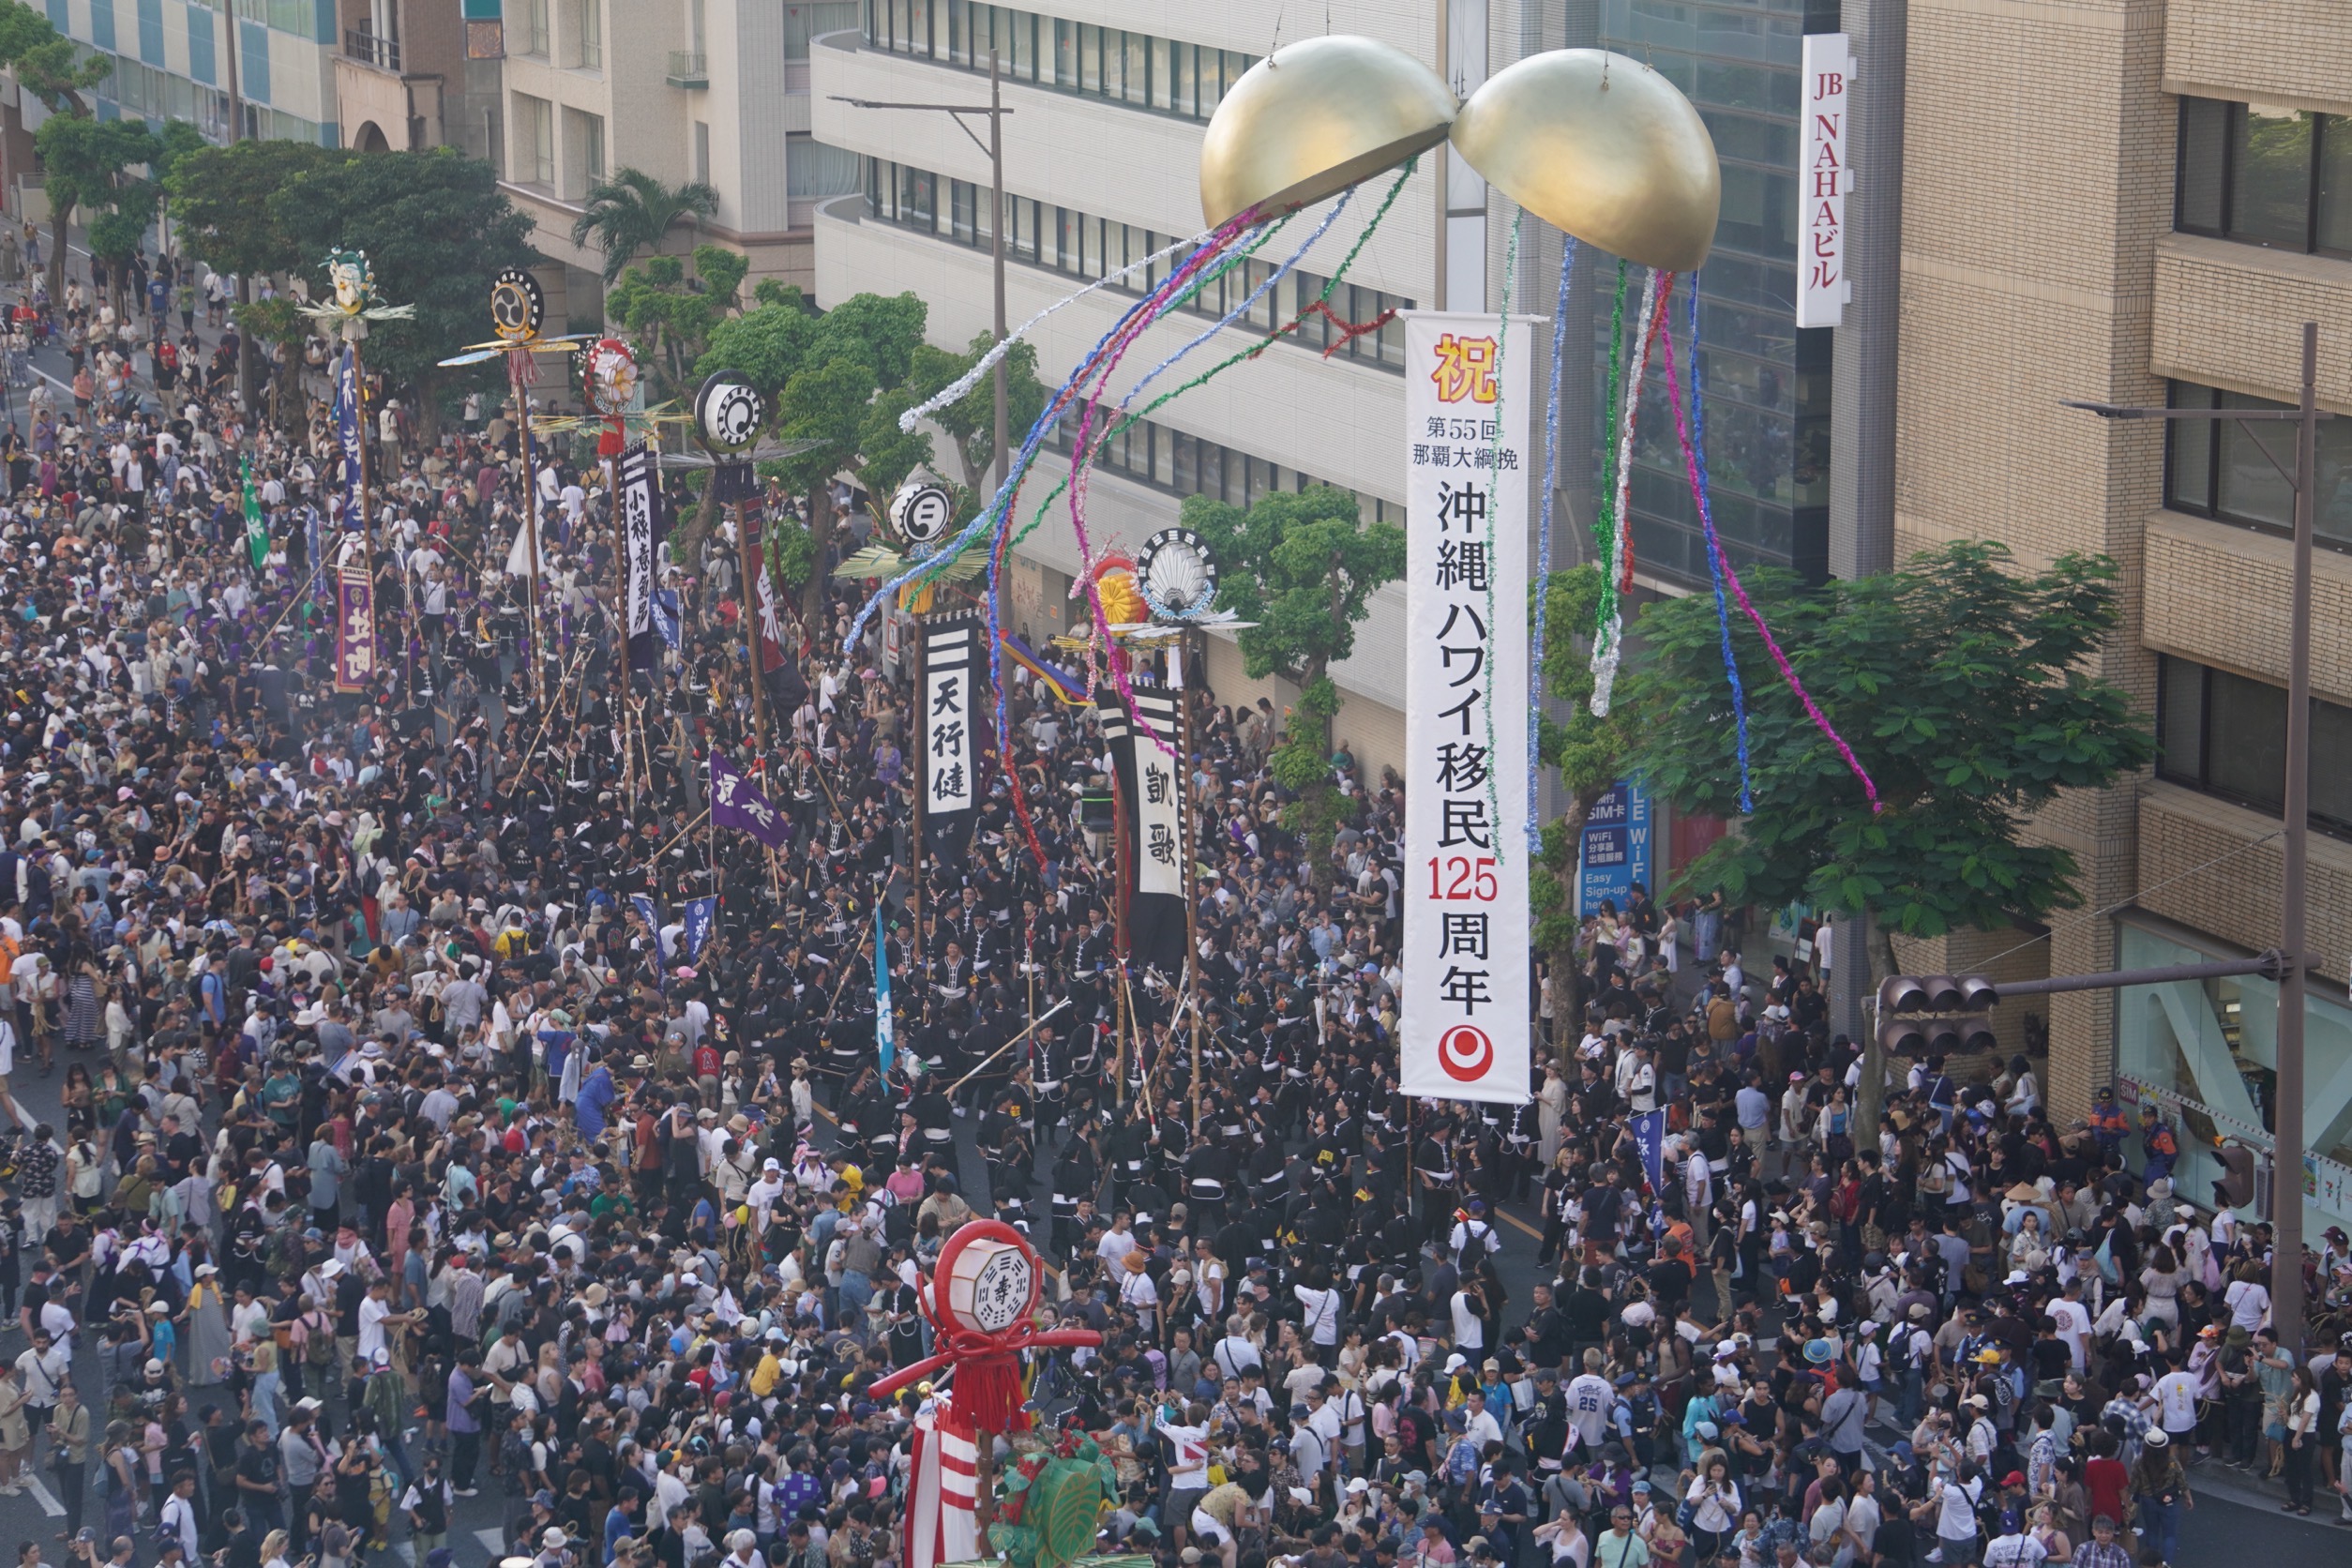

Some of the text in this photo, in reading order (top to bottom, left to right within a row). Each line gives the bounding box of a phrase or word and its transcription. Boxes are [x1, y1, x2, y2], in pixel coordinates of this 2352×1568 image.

[1809, 73, 1843, 290] JB NAHAビル
[1432, 333, 1499, 404] 祝
[1426, 416, 1501, 441] 第55回
[1413, 444, 1518, 471] 那覇大綱挽
[932, 676, 968, 801] 天行健
[1146, 761, 1176, 867] 凱歌
[1589, 832, 1612, 843] WiFi
[1630, 828, 1647, 883] WiF
[1586, 873, 1612, 884] Easy
[1586, 884, 1627, 898] Sign-up
[1579, 1397, 1597, 1412] 25
[1993, 1545, 2017, 1553] SHIFT
